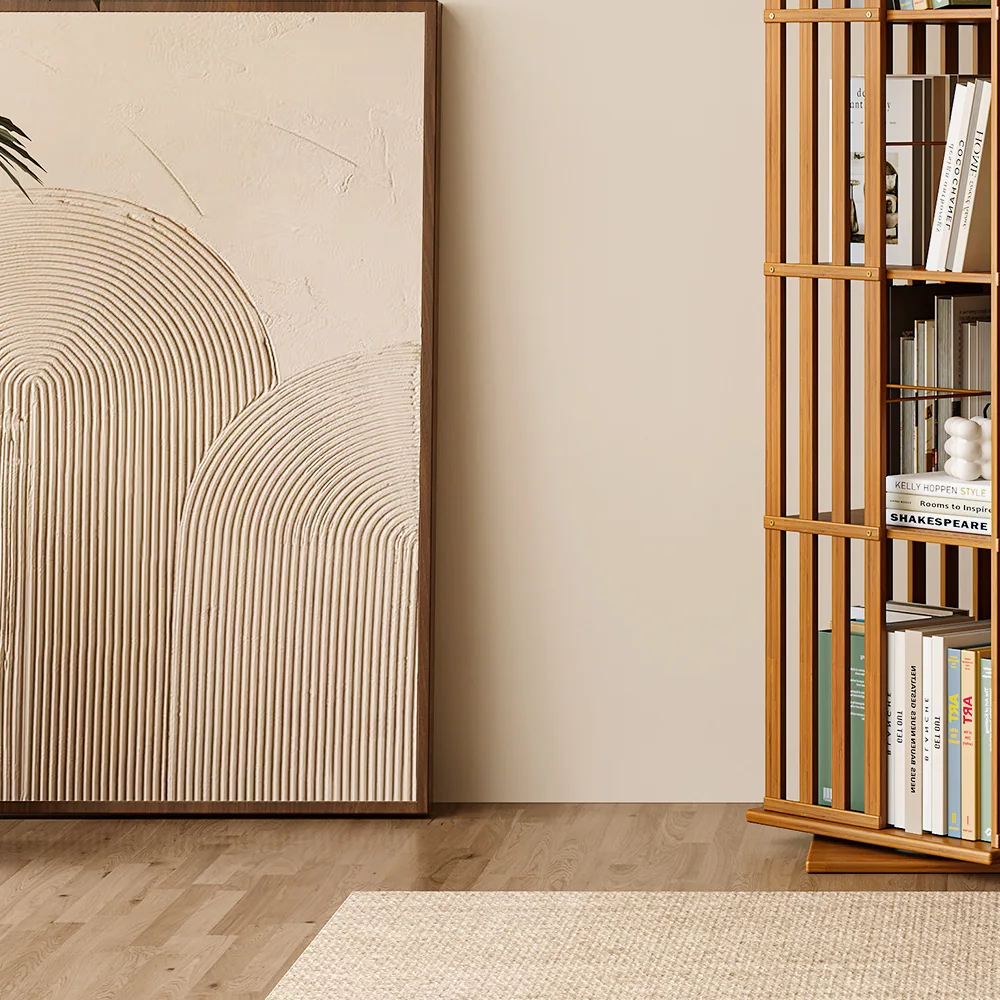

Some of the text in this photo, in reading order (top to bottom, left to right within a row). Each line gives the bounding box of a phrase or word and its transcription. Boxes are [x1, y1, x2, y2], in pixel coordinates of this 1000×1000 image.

[895, 481, 987, 497] KELLY HOPPEN STYLE
[920, 500, 949, 510] Rooms
[890, 513, 988, 531] SHAKESPEARE
